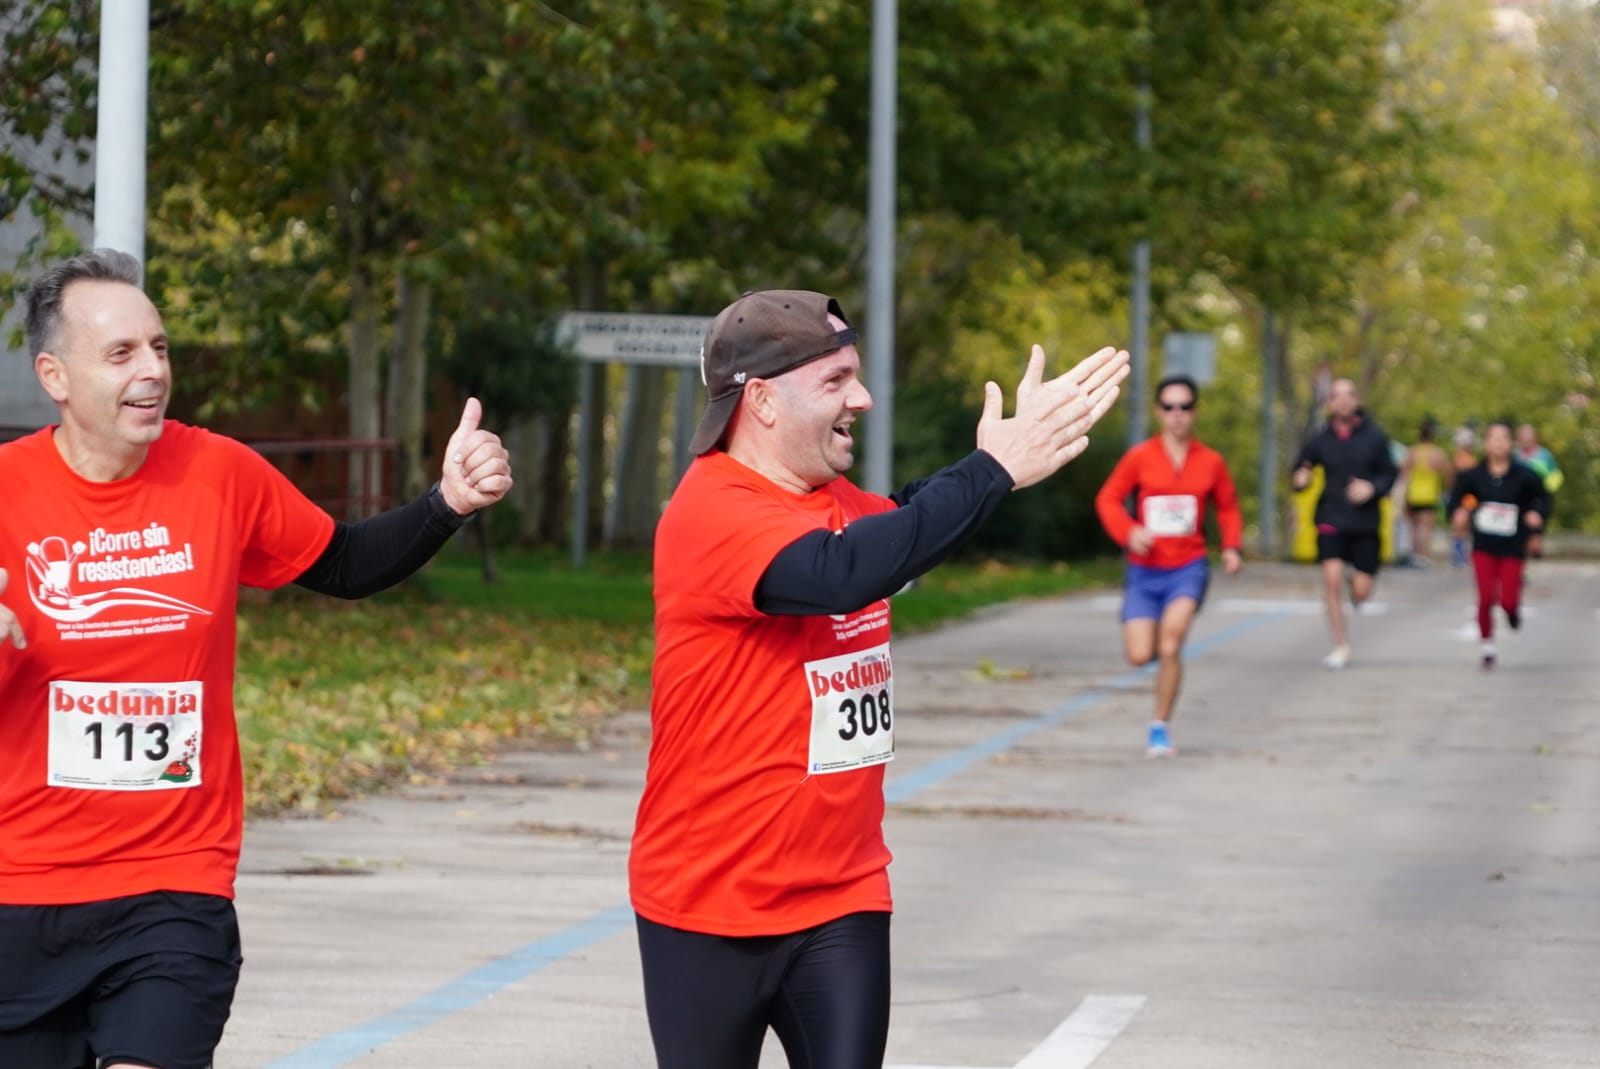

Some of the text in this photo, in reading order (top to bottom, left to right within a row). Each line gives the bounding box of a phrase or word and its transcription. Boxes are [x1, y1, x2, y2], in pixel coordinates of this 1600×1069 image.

[88, 522, 170, 556] ¡Corre sin
[78, 543, 194, 582] resistencias!
[55, 687, 197, 716] bedunia
[838, 689, 891, 741] 308
[84, 721, 170, 761] 113
